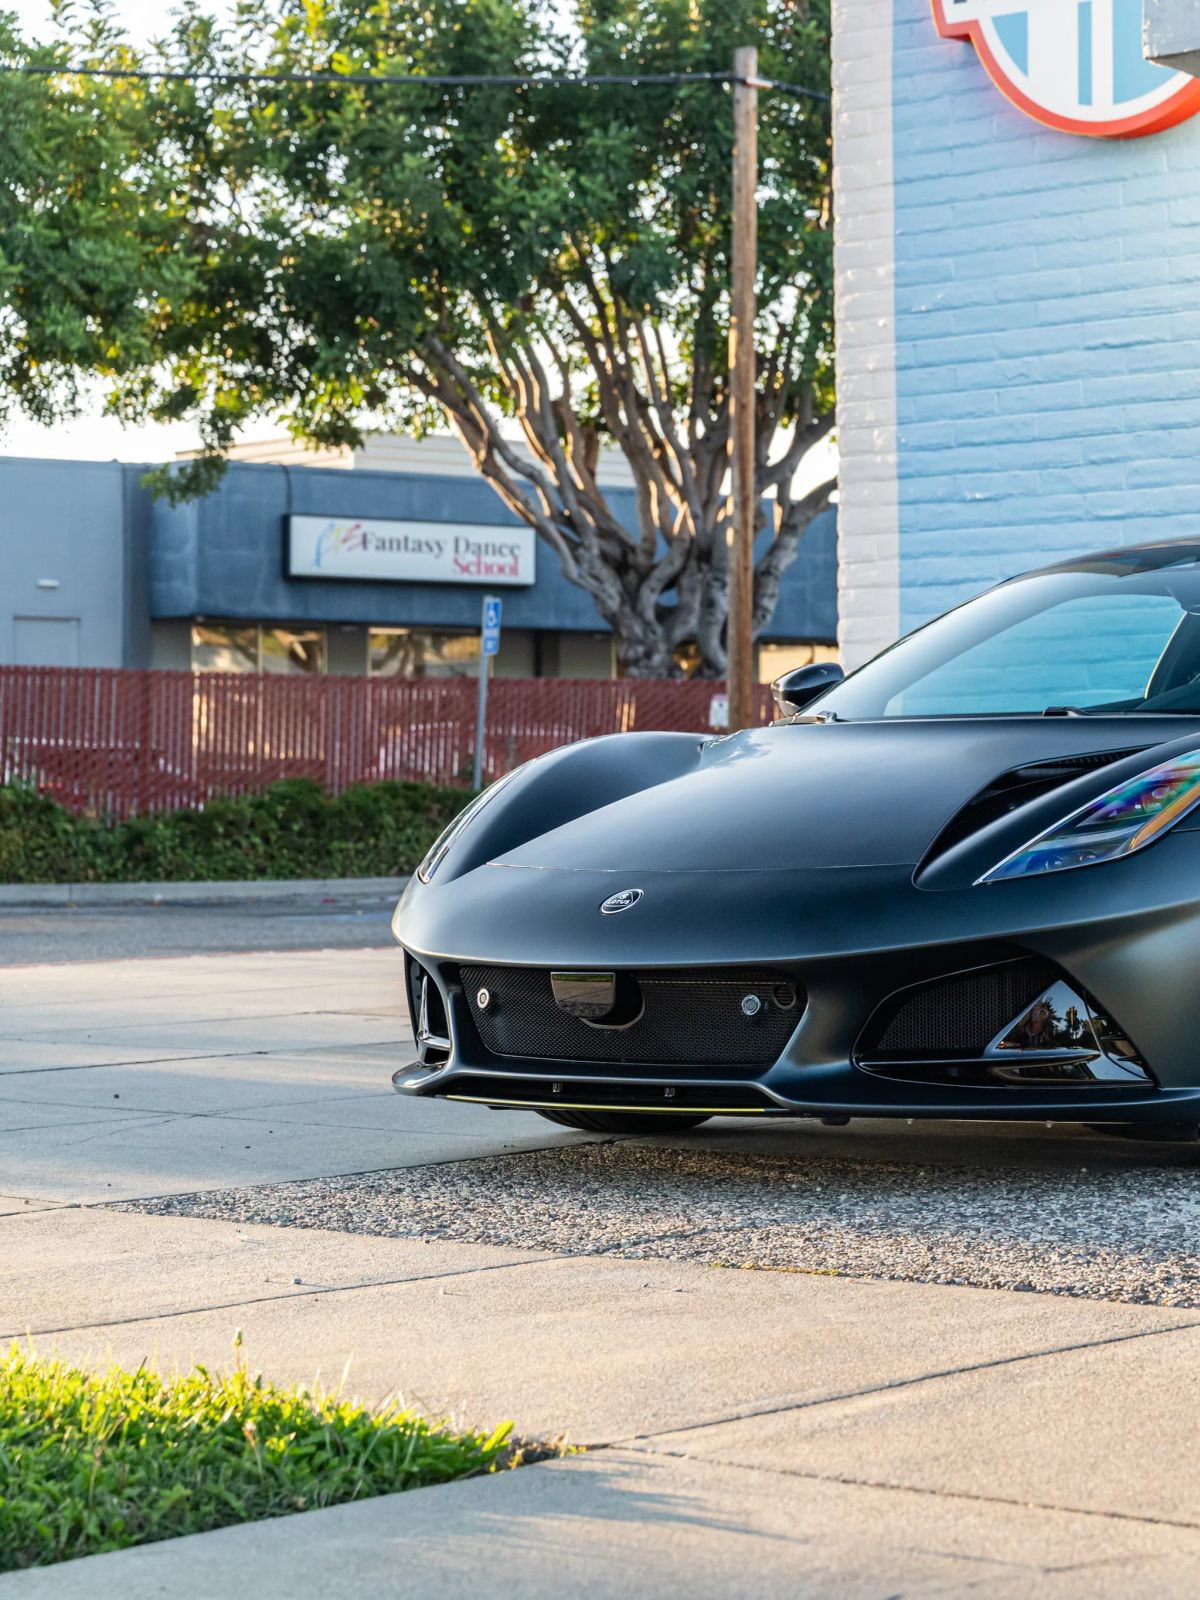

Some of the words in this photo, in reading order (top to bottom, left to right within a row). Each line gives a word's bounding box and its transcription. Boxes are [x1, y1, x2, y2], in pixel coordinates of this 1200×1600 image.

[361, 531, 446, 558] Fantasy
[453, 535, 521, 558] Dance
[453, 555, 519, 577] School
